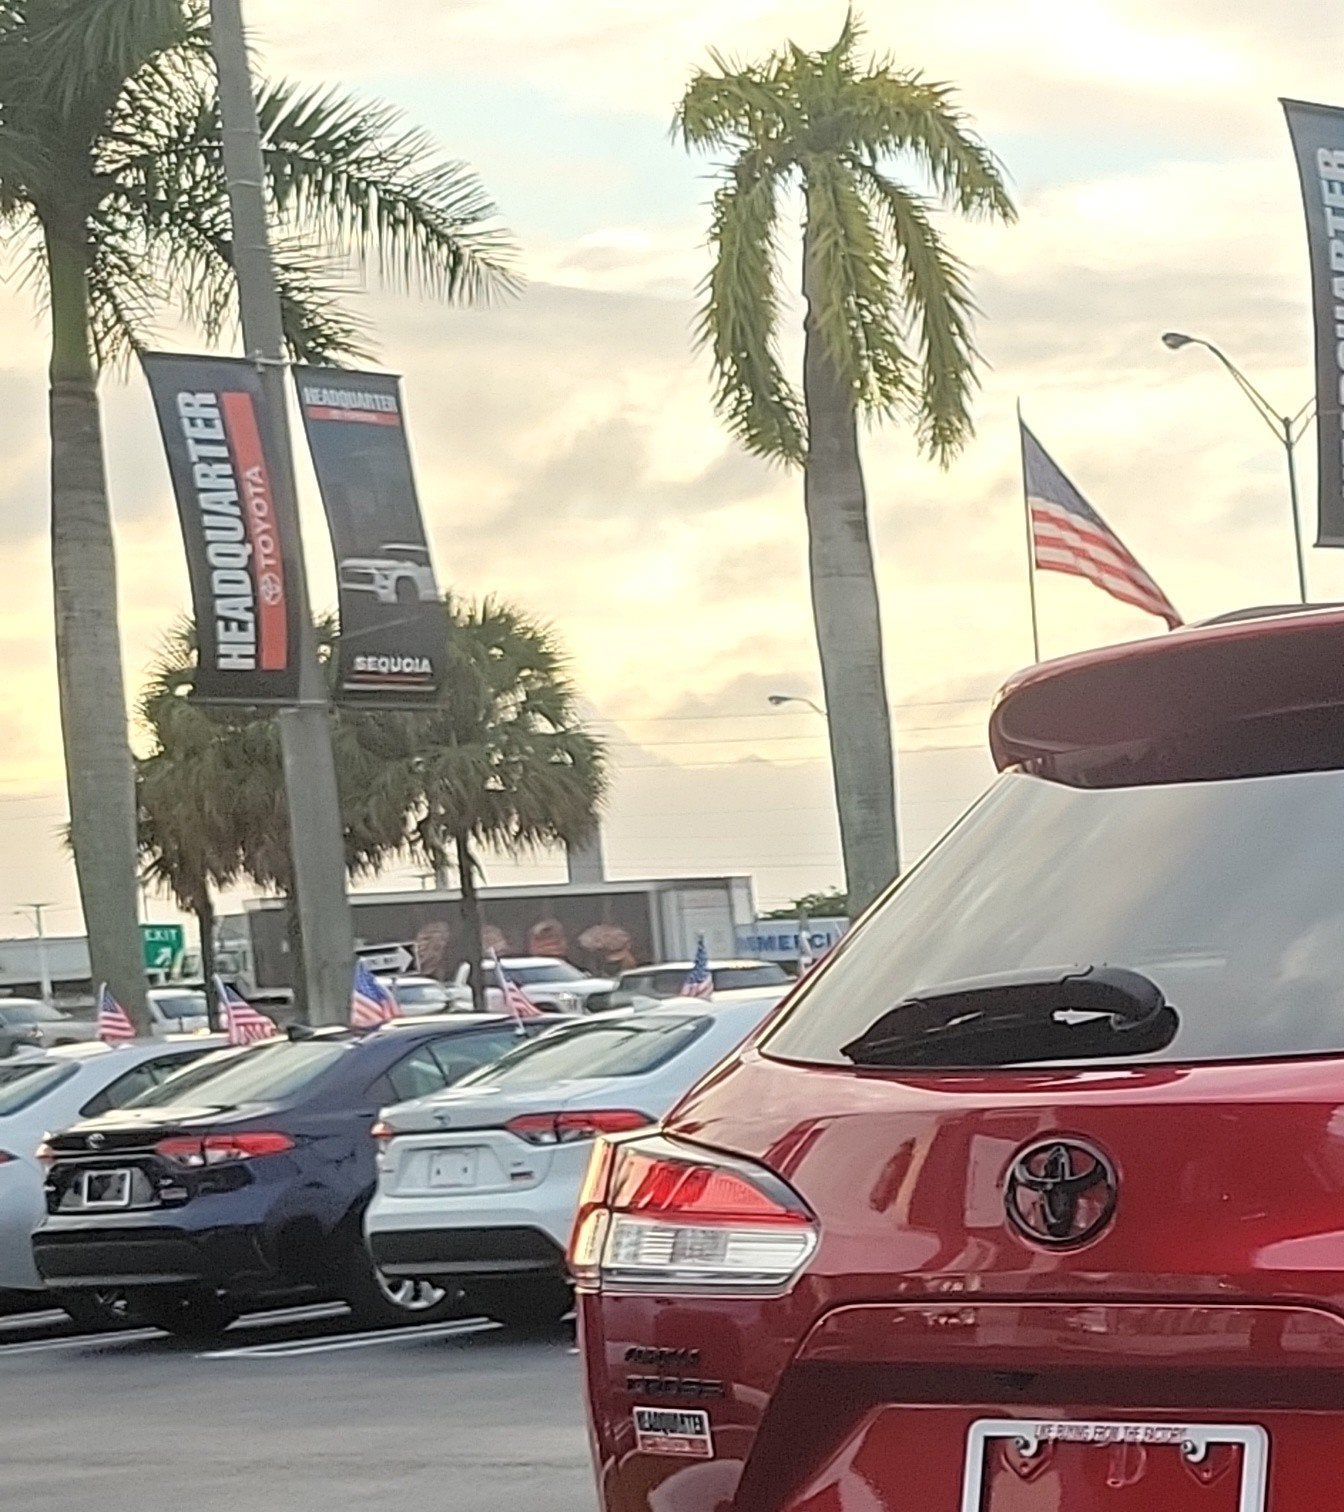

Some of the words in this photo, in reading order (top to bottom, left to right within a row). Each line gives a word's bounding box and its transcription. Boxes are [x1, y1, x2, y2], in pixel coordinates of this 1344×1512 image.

[303, 387, 398, 412] HEADQUARTER
[247, 467, 279, 568] TOYOTA
[176, 391, 257, 672] HEADQUARTER
[353, 654, 433, 676] SEQUOIA
[144, 929, 178, 941] EXIT
